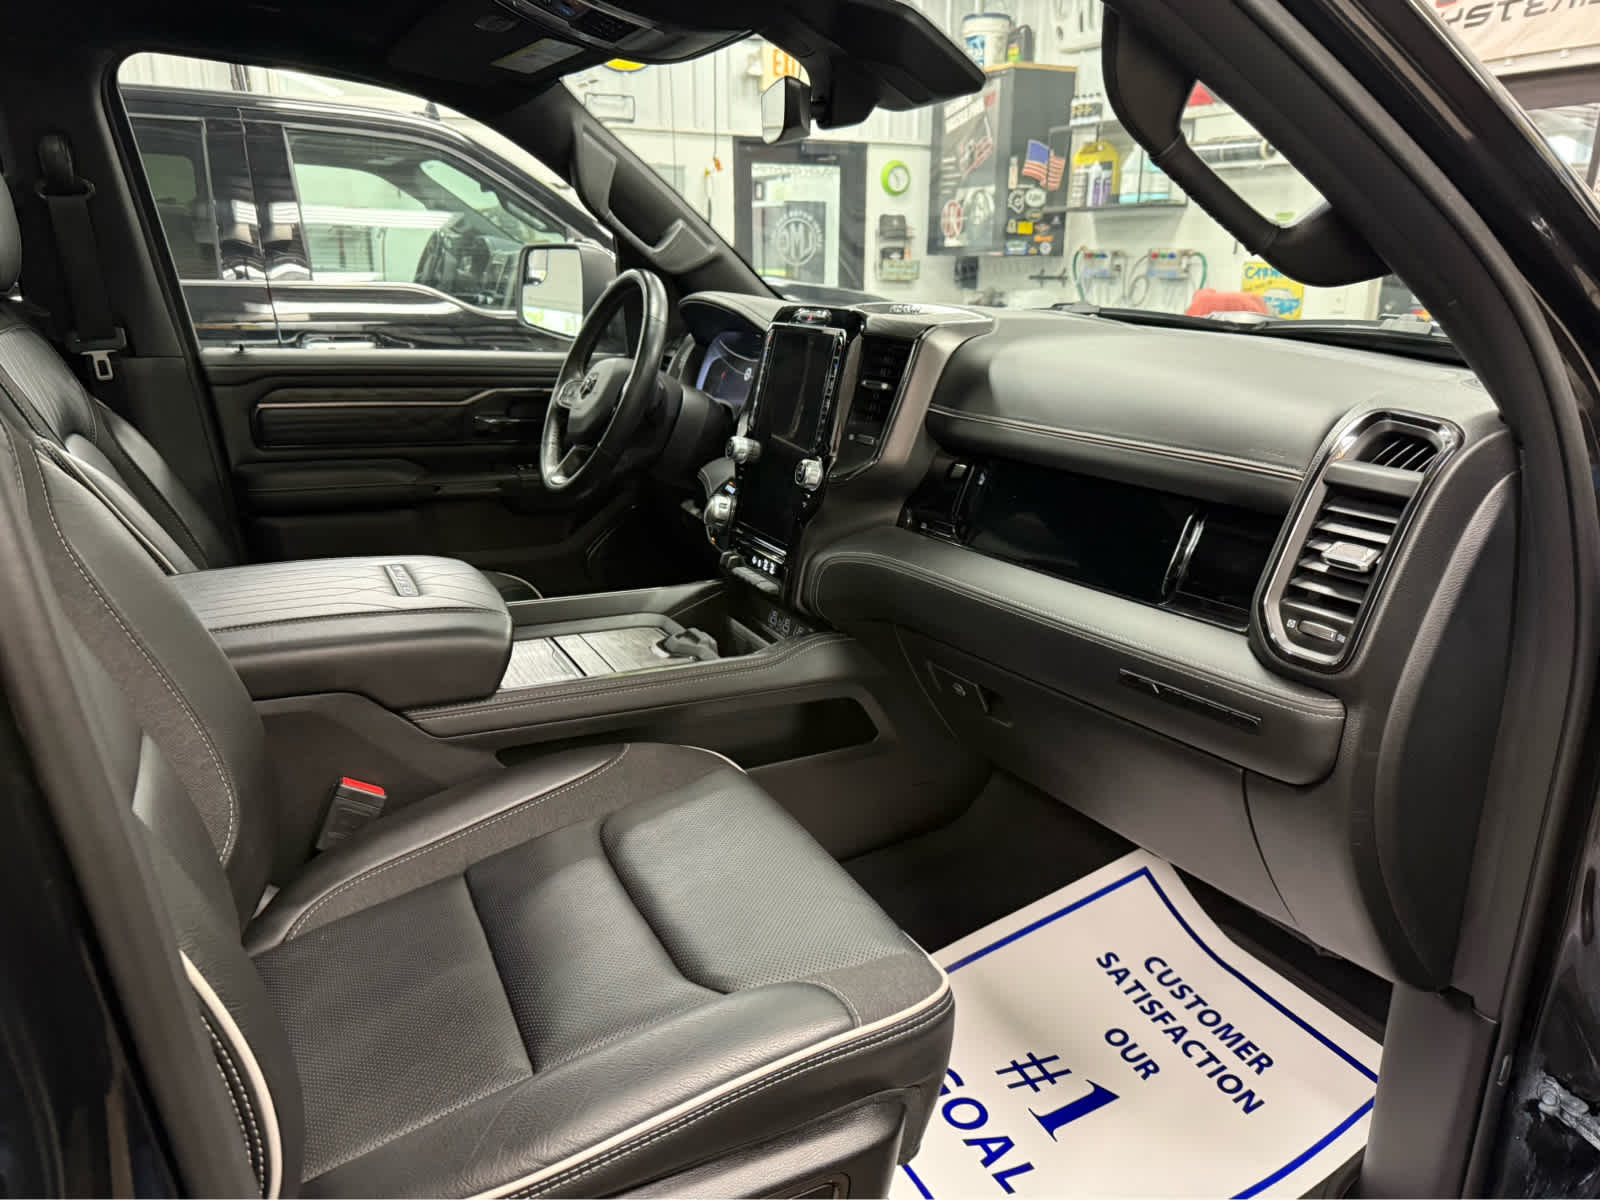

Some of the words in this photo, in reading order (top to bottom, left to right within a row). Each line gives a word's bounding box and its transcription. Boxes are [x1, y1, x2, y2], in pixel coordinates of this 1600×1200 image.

[1096, 951, 1265, 1115] SATISFACTION
[1104, 1028, 1161, 1081] OUR
[1144, 956, 1274, 1075] CUSTOMER
[996, 1052, 1120, 1142] #1
